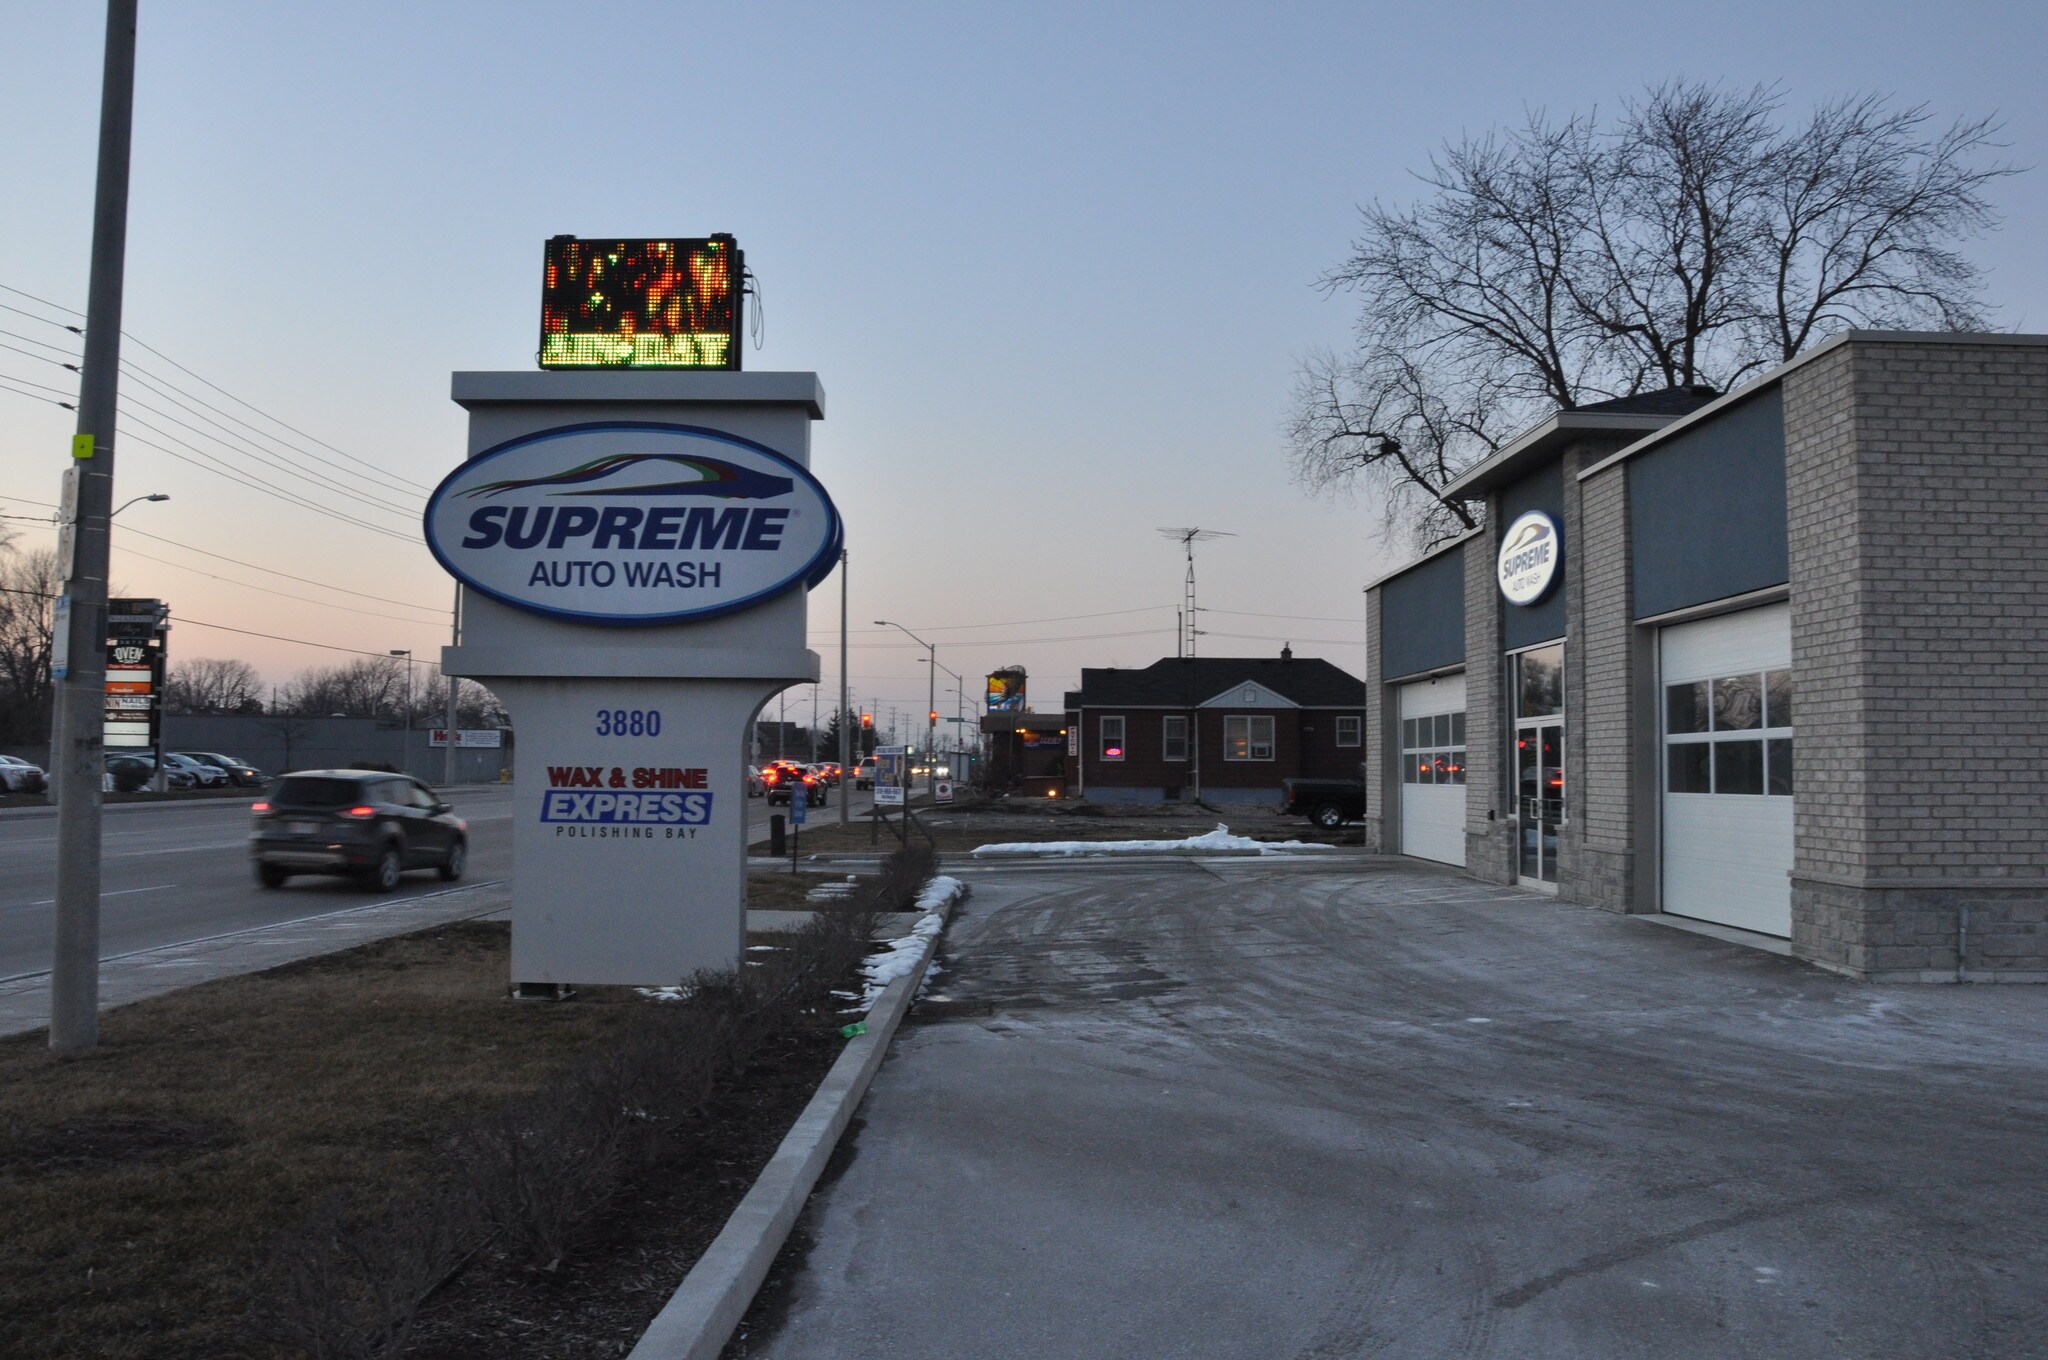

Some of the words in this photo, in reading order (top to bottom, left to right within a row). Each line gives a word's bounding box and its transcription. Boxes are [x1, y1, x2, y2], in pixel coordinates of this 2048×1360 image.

[462, 506, 790, 550] SUPREME
[528, 560, 615, 588] AUTO
[622, 561, 721, 588] WASH
[1503, 541, 1550, 580] SUPREME
[1512, 577, 1525, 591] AUTO
[1526, 571, 1541, 587] WASH
[115, 647, 143, 660] OVEN
[596, 709, 661, 737] 3880
[1069, 726, 1077, 755] PSYCHIC
[547, 767, 603, 788] WAX
[608, 767, 627, 788] &
[632, 767, 708, 789] SHINE
[547, 793, 708, 822] EXPRESS
[556, 826, 654, 839] POLISHING
[666, 827, 698, 839] BAY
